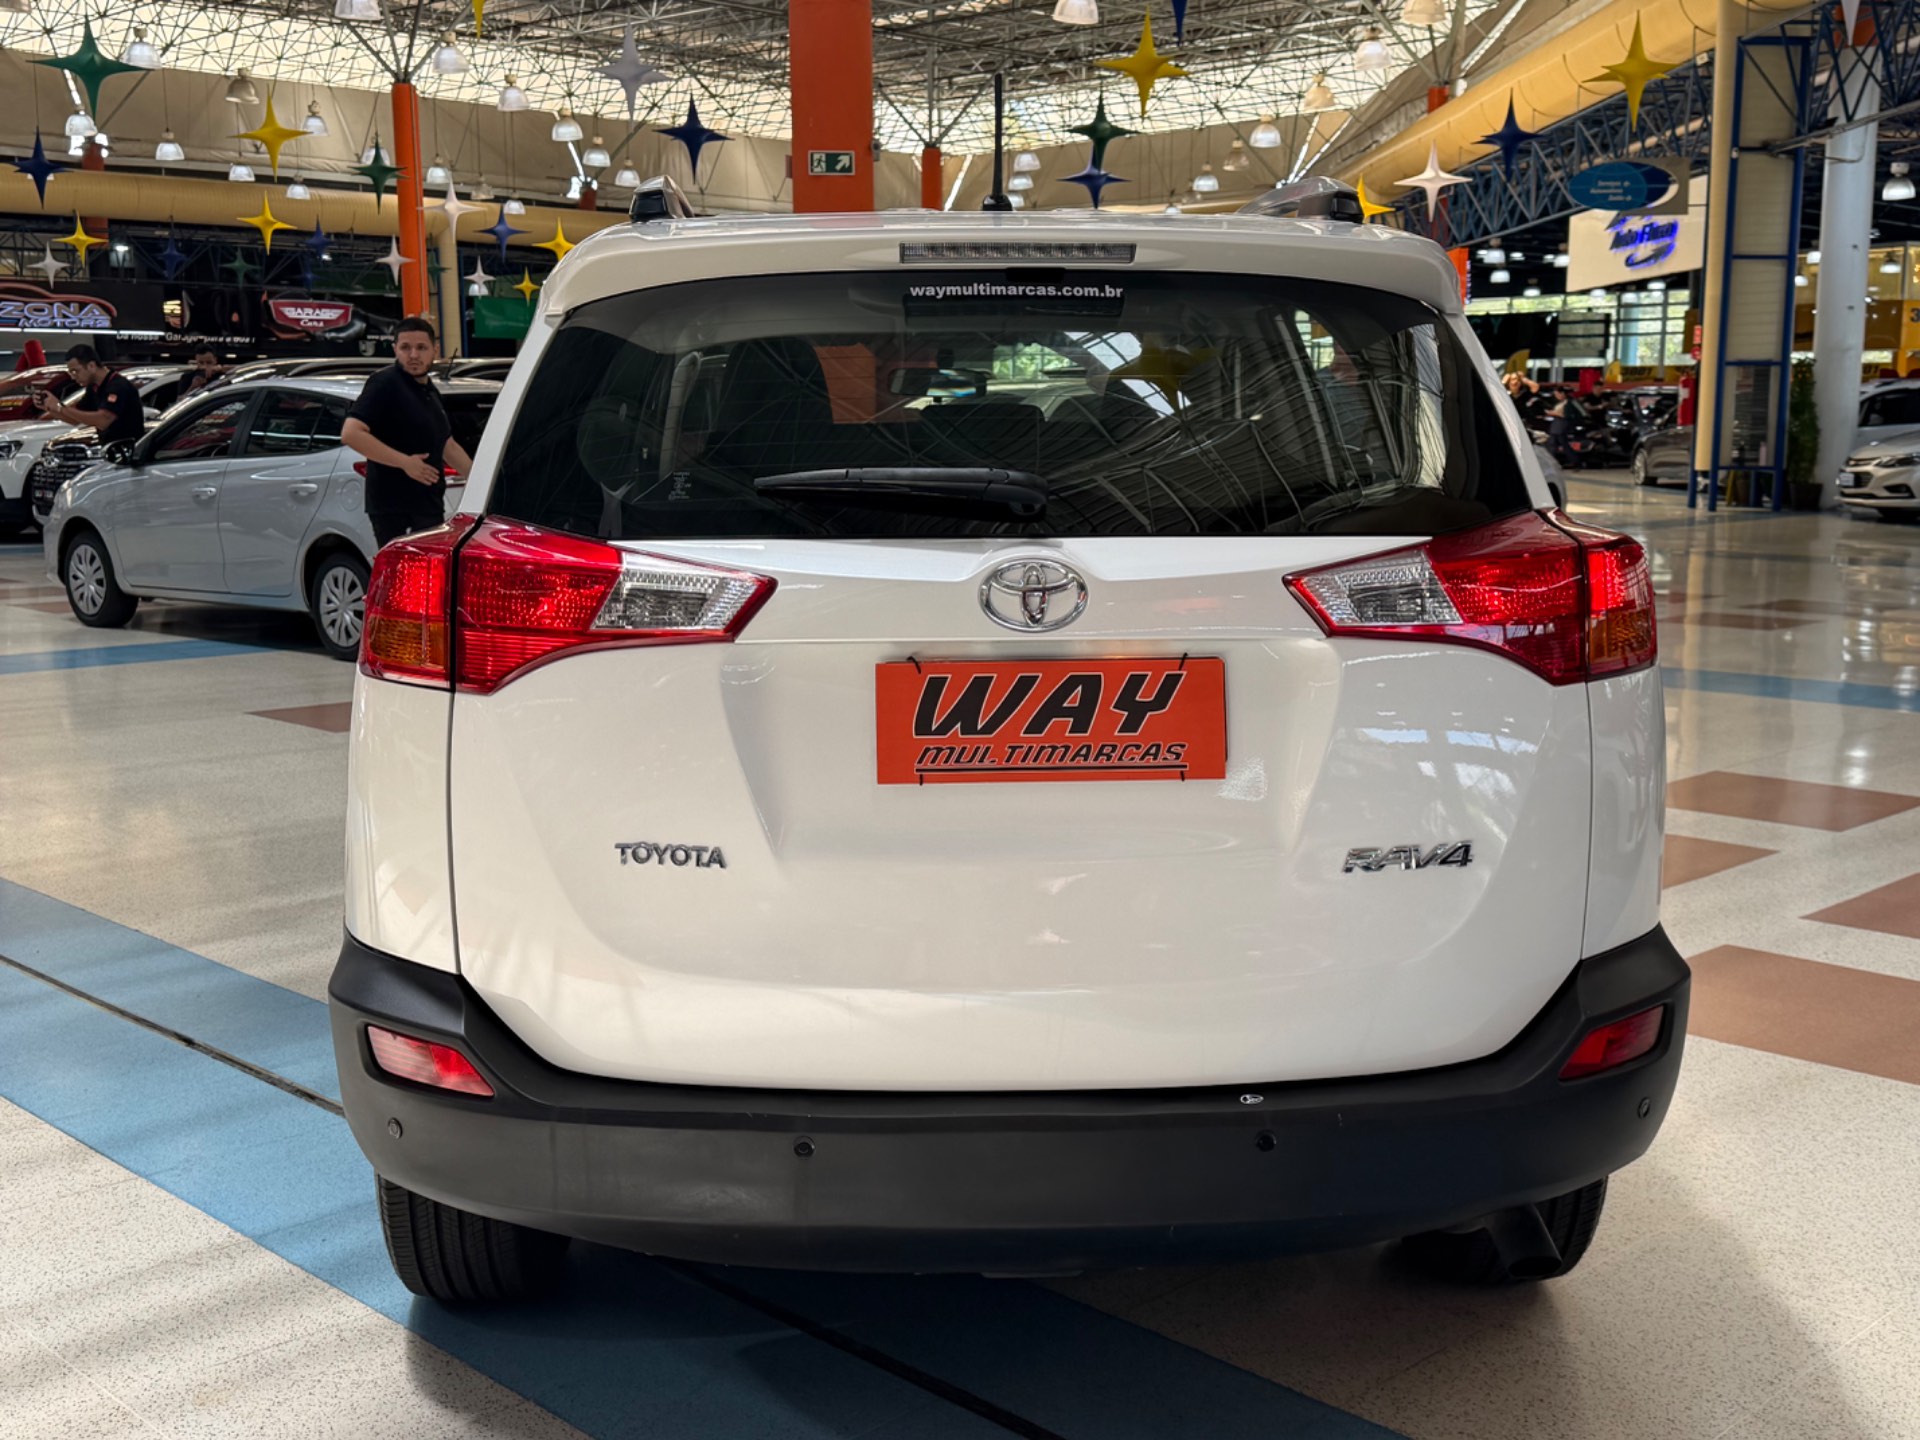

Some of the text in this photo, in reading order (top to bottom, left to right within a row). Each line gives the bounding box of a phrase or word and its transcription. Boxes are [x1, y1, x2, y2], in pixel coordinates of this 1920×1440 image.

[909, 282, 1124, 299] waymultimarcas.com.br
[18, 317, 112, 328] MOTORS
[912, 670, 1188, 738] WAY
[915, 742, 1190, 766] MULTIMARCAS
[614, 841, 727, 869] TOYOTA
[1342, 839, 1474, 873] RAV4
